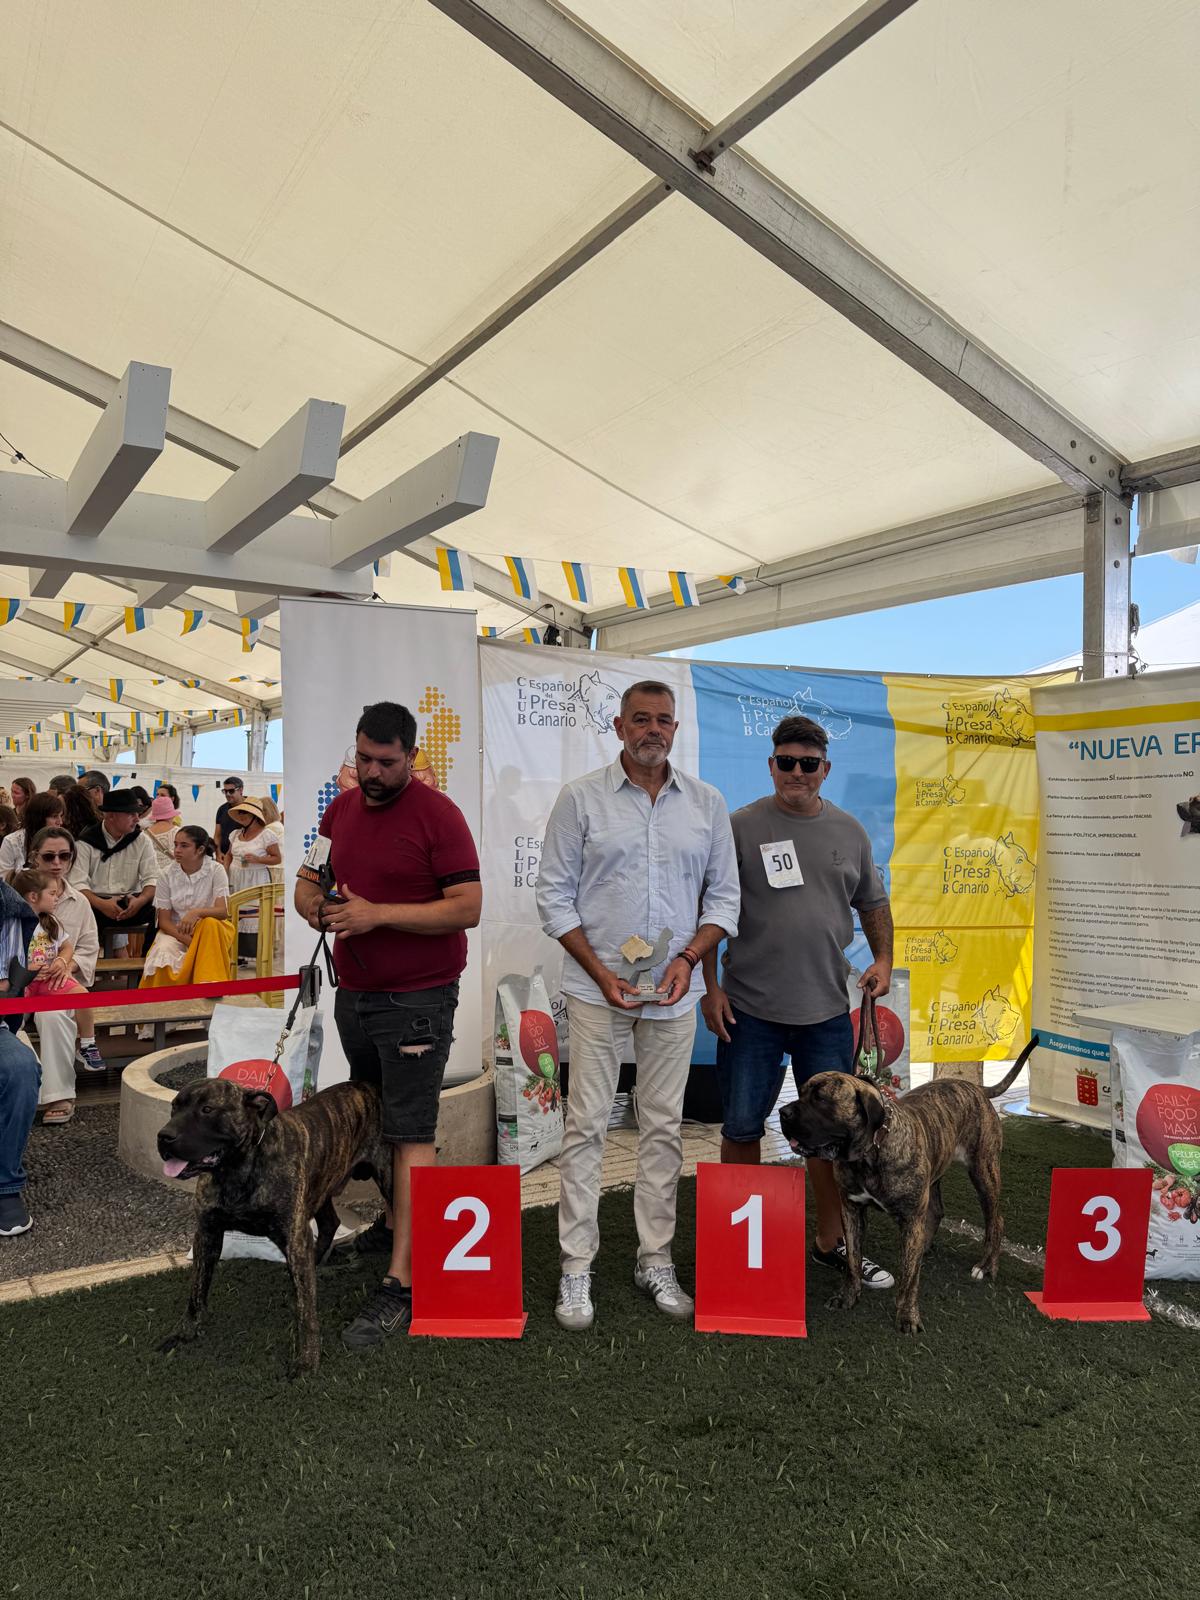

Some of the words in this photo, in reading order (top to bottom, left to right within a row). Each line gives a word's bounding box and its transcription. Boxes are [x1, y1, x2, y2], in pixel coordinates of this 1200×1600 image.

[529, 679, 576, 692] Español
[530, 694, 575, 712] Presa
[749, 695, 793, 708] Español
[952, 701, 992, 712] Español
[529, 711, 576, 727] Canario
[754, 709, 785, 722] Pre
[955, 716, 992, 730] Presa
[955, 732, 994, 744] Canario
[921, 789, 943, 798] Presa
[954, 847, 993, 860] Español
[772, 853, 793, 872] 50
[953, 864, 991, 878] Presa
[951, 880, 989, 893] Canario
[911, 945, 931, 954] Presa
[910, 953, 931, 962] Canario
[941, 1000, 979, 1014] Español
[939, 1018, 976, 1031] Presa
[936, 1031, 974, 1046] Canario
[237, 1068, 270, 1083] DAIL
[1154, 1093, 1191, 1106] DAILY
[1157, 1106, 1198, 1121] FOOD
[1179, 1160, 1198, 1169] diet
[442, 1196, 491, 1271] 2
[730, 1194, 763, 1269] 1
[1078, 1195, 1122, 1262] 3
